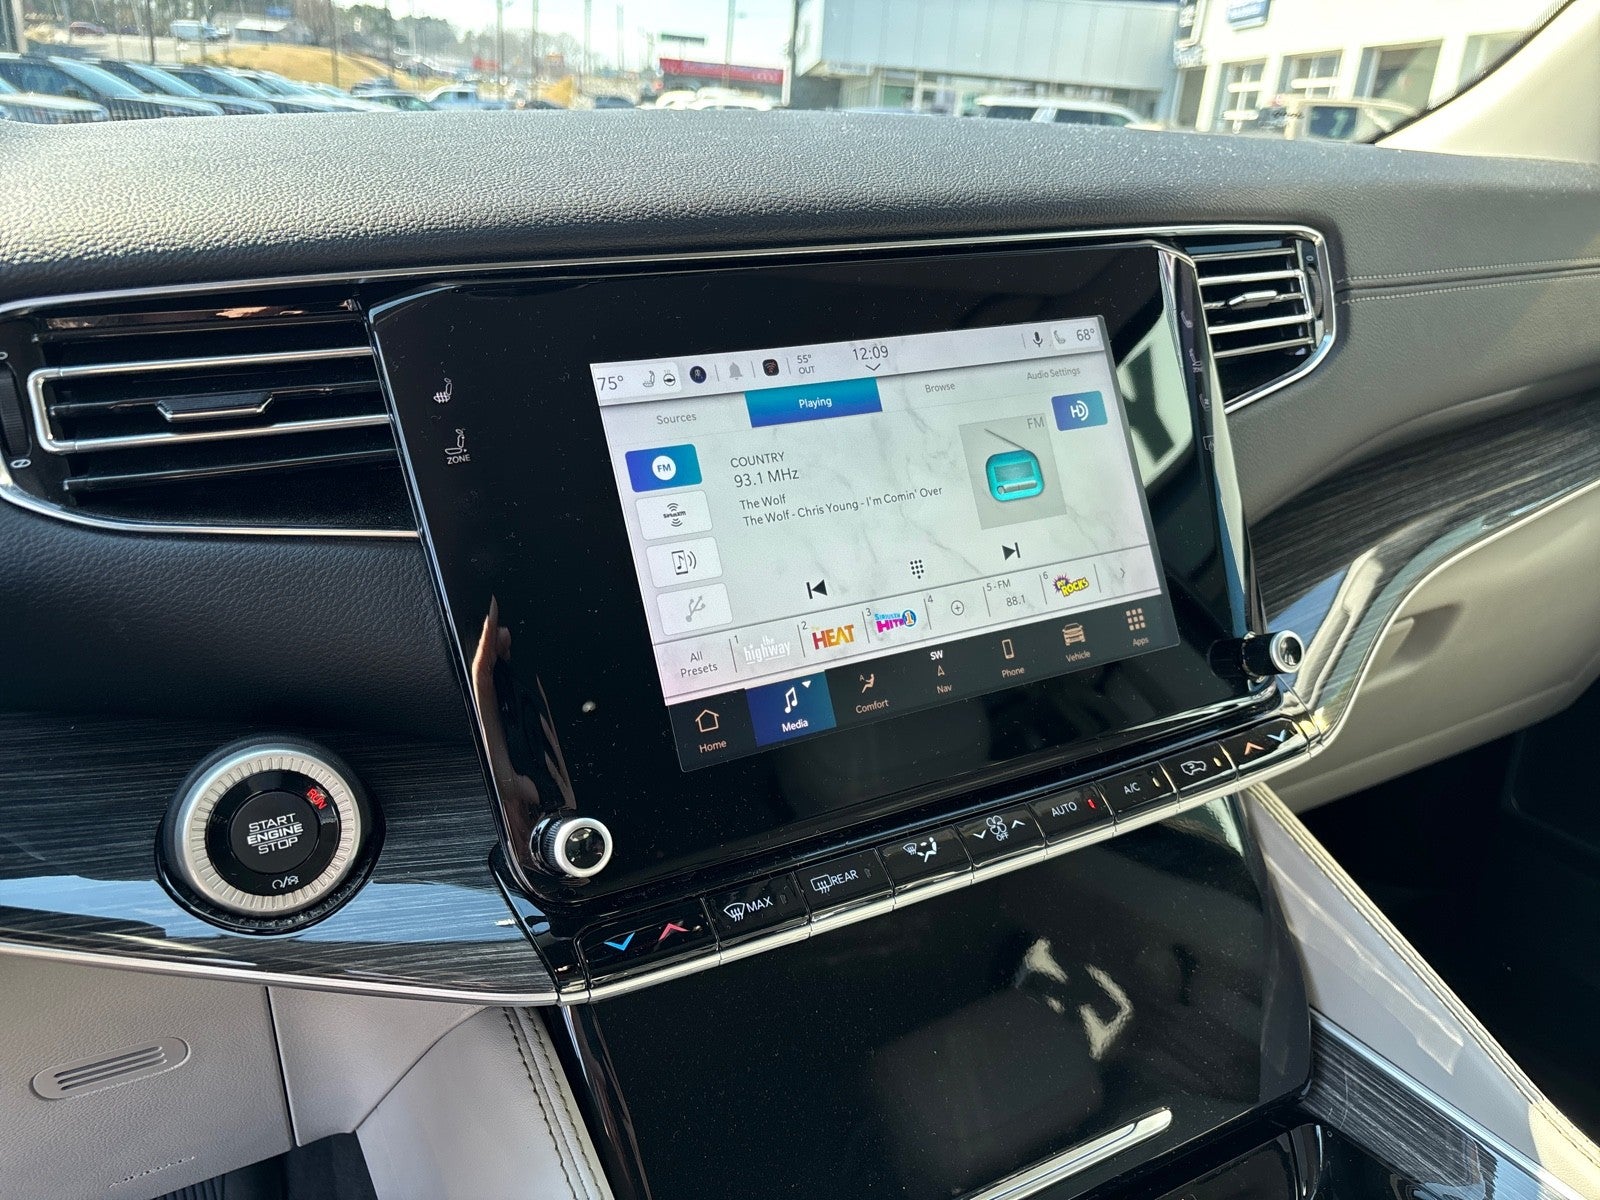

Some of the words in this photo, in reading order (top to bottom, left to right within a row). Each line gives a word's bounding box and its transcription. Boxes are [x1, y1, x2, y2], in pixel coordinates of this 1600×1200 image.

[1076, 328, 1095, 342] 68°
[796, 354, 812, 364] 55°
[852, 345, 889, 361] 12:09
[798, 365, 815, 375] OUT
[1026, 368, 1049, 381] Audio
[1049, 366, 1081, 379] Settings
[597, 375, 624, 391] 75°
[925, 381, 956, 393] Browse
[798, 396, 833, 410] Playing
[656, 411, 697, 425] Sources
[1026, 417, 1045, 429] FM
[446, 454, 471, 465] ZONE
[730, 452, 785, 468] COUNTRY
[657, 463, 672, 473] FM
[734, 473, 763, 488] 93.1
[768, 468, 800, 484] MHz
[739, 499, 761, 512] The
[762, 494, 786, 507] Wolf
[743, 515, 764, 527] The
[765, 511, 790, 523] Wolf
[797, 504, 825, 519] Chris
[826, 501, 859, 516] Young
[866, 496, 883, 508] I'm
[884, 489, 917, 505] Comin'
[920, 486, 943, 499] Over
[1042, 571, 1048, 580] 6
[1061, 577, 1089, 597] ROCKS
[927, 595, 933, 603] 4
[1006, 594, 1026, 607] 88.1
[865, 608, 872, 617] 3
[802, 621, 808, 630] 2
[762, 635, 775, 646] the
[812, 624, 855, 650] HEAT
[1132, 636, 1149, 648] Apps
[690, 651, 704, 662] All
[743, 641, 790, 663] highway
[930, 650, 944, 661] SW
[1065, 650, 1091, 663] Vehicle
[680, 663, 718, 678] Presets
[1001, 666, 1025, 678] Phone
[936, 683, 952, 694] Nav
[855, 699, 889, 714] Comfort
[781, 718, 809, 733] Media
[699, 739, 727, 753] Home
[1124, 782, 1141, 796] A/C
[306, 788, 326, 809] RUN
[1051, 801, 1078, 818] AUTO
[248, 812, 297, 833] START
[246, 823, 304, 846] ENGINE
[995, 831, 1010, 842] OFF
[258, 836, 299, 855] STOP
[830, 869, 859, 886] REAR
[746, 895, 774, 914] MAX
